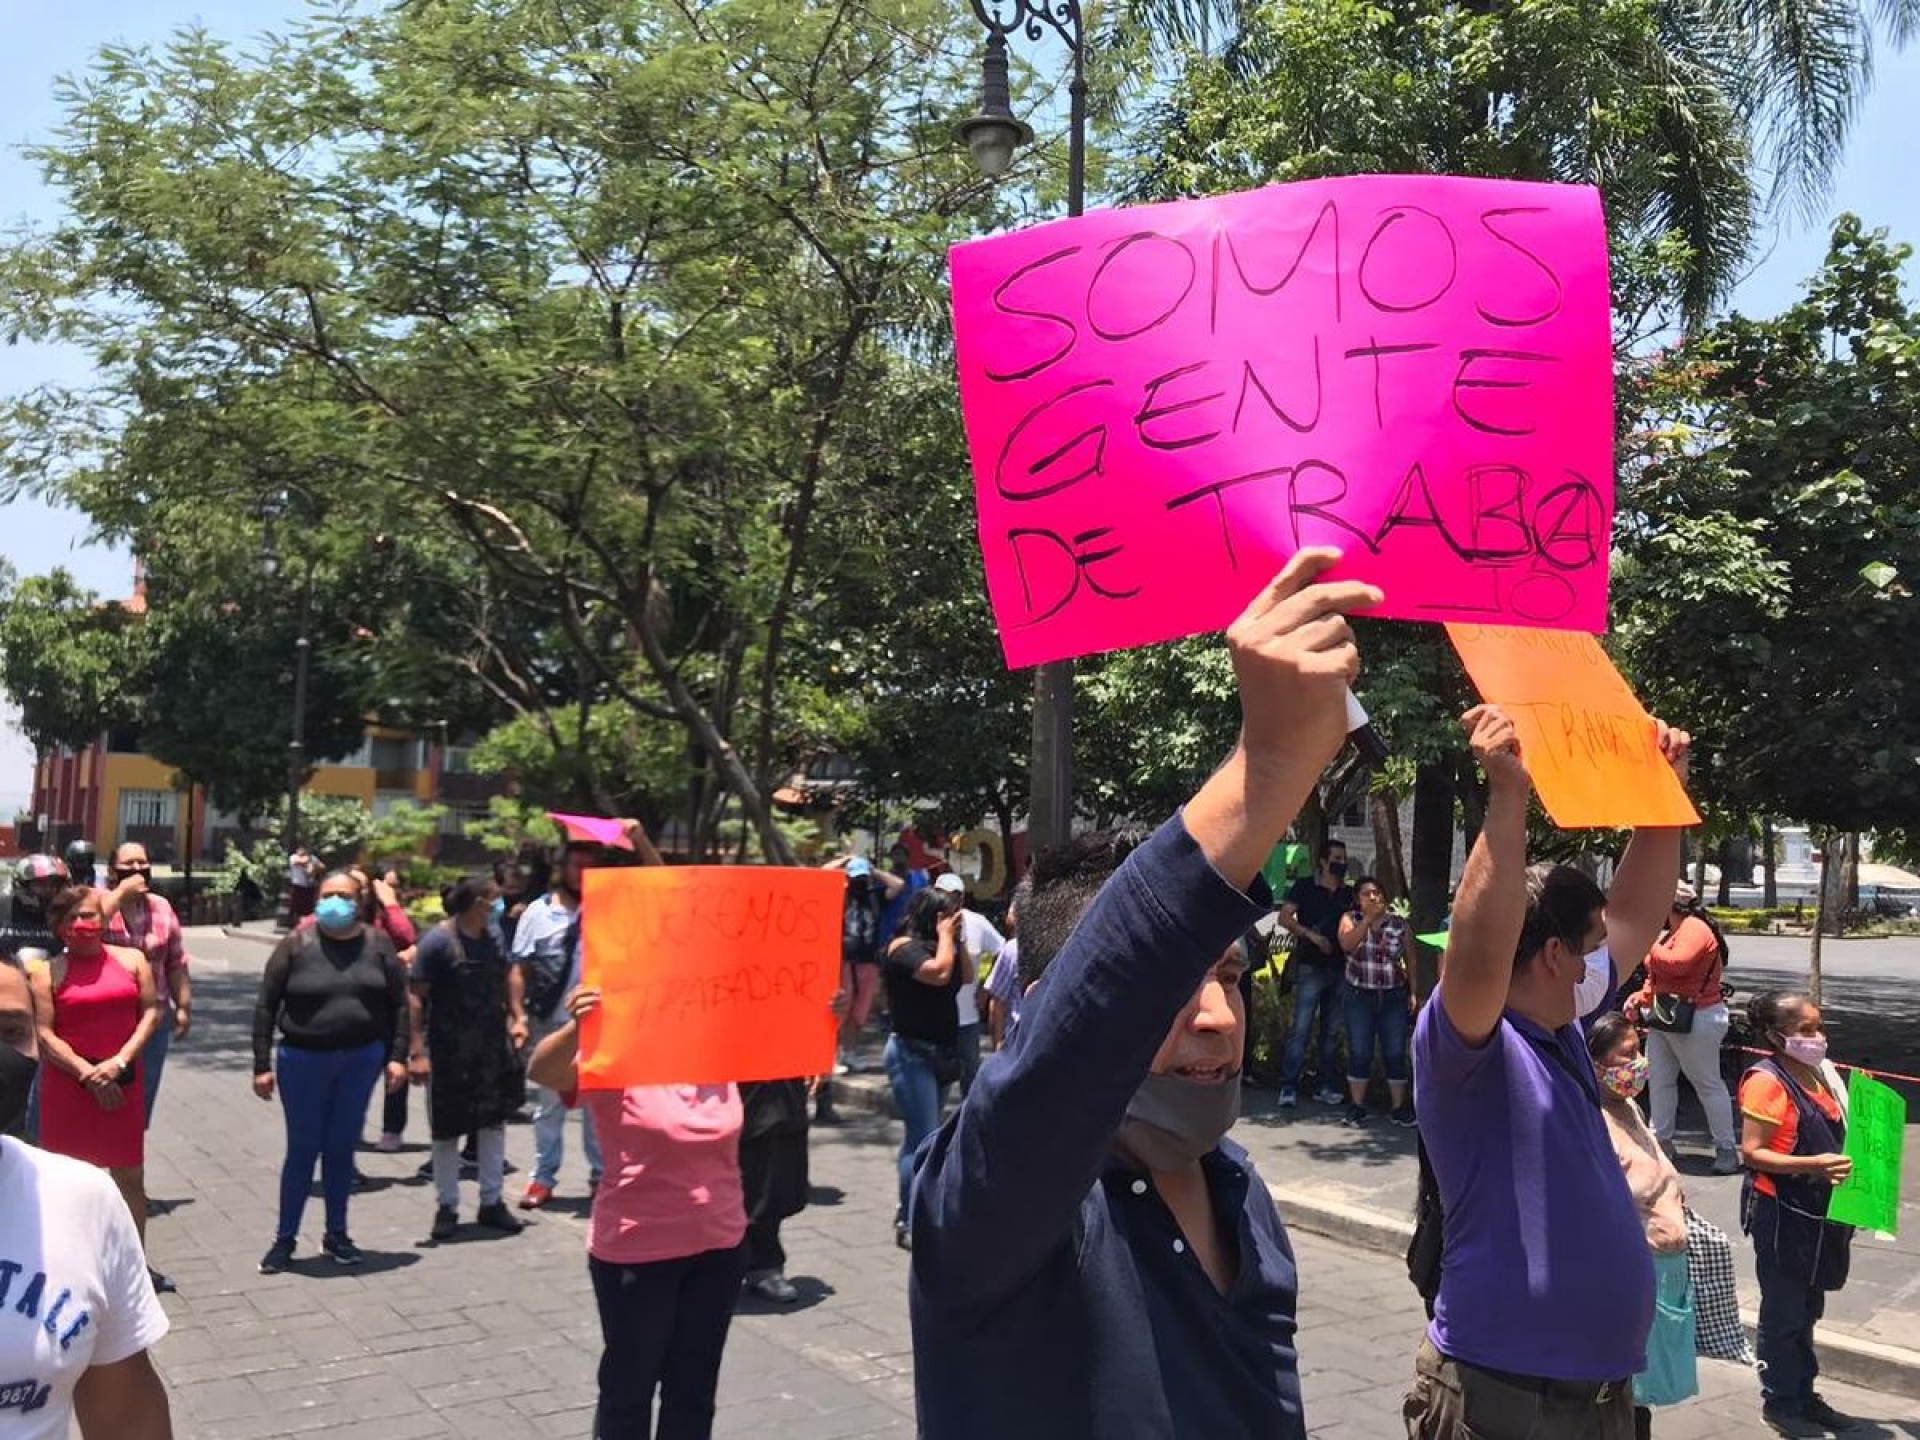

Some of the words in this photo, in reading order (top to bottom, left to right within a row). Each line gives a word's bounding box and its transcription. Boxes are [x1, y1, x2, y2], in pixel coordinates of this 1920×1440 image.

[985, 199, 1563, 382] SOMOS
[996, 335, 1560, 500] GENTE
[1008, 526, 1143, 628] DE
[607, 881, 822, 947] QUEREMOS
